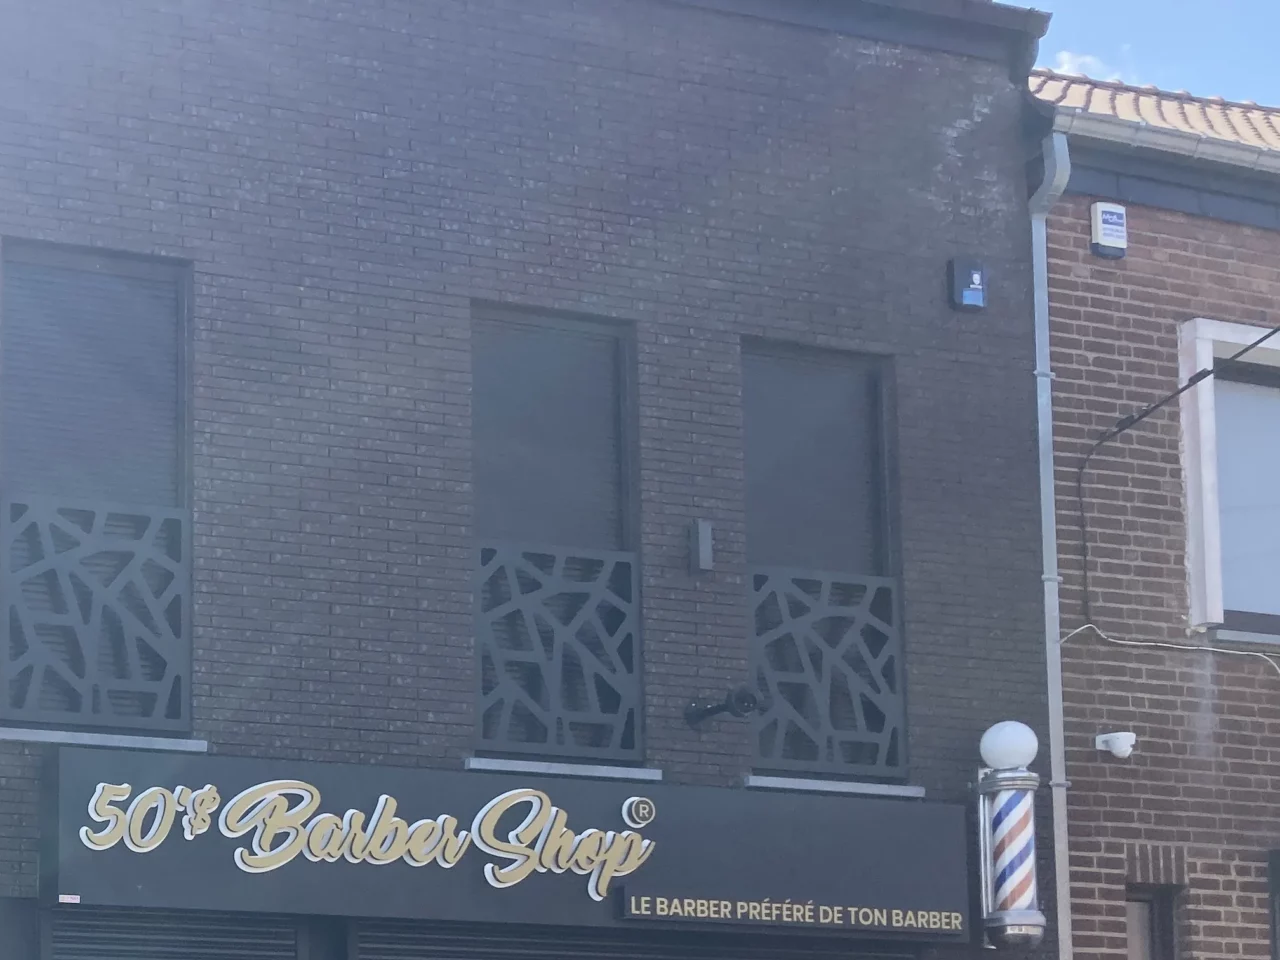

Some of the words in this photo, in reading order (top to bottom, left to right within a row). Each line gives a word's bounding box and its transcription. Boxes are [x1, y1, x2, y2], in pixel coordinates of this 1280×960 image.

[218, 779, 472, 874] Barber
[471, 788, 656, 901] Shop
[631, 896, 651, 915] LE
[656, 897, 732, 919] BARBER
[736, 898, 815, 923] PRÉFÉRÉ
[820, 905, 844, 924] DE
[847, 907, 887, 926] TON
[892, 908, 963, 930] BARBER
